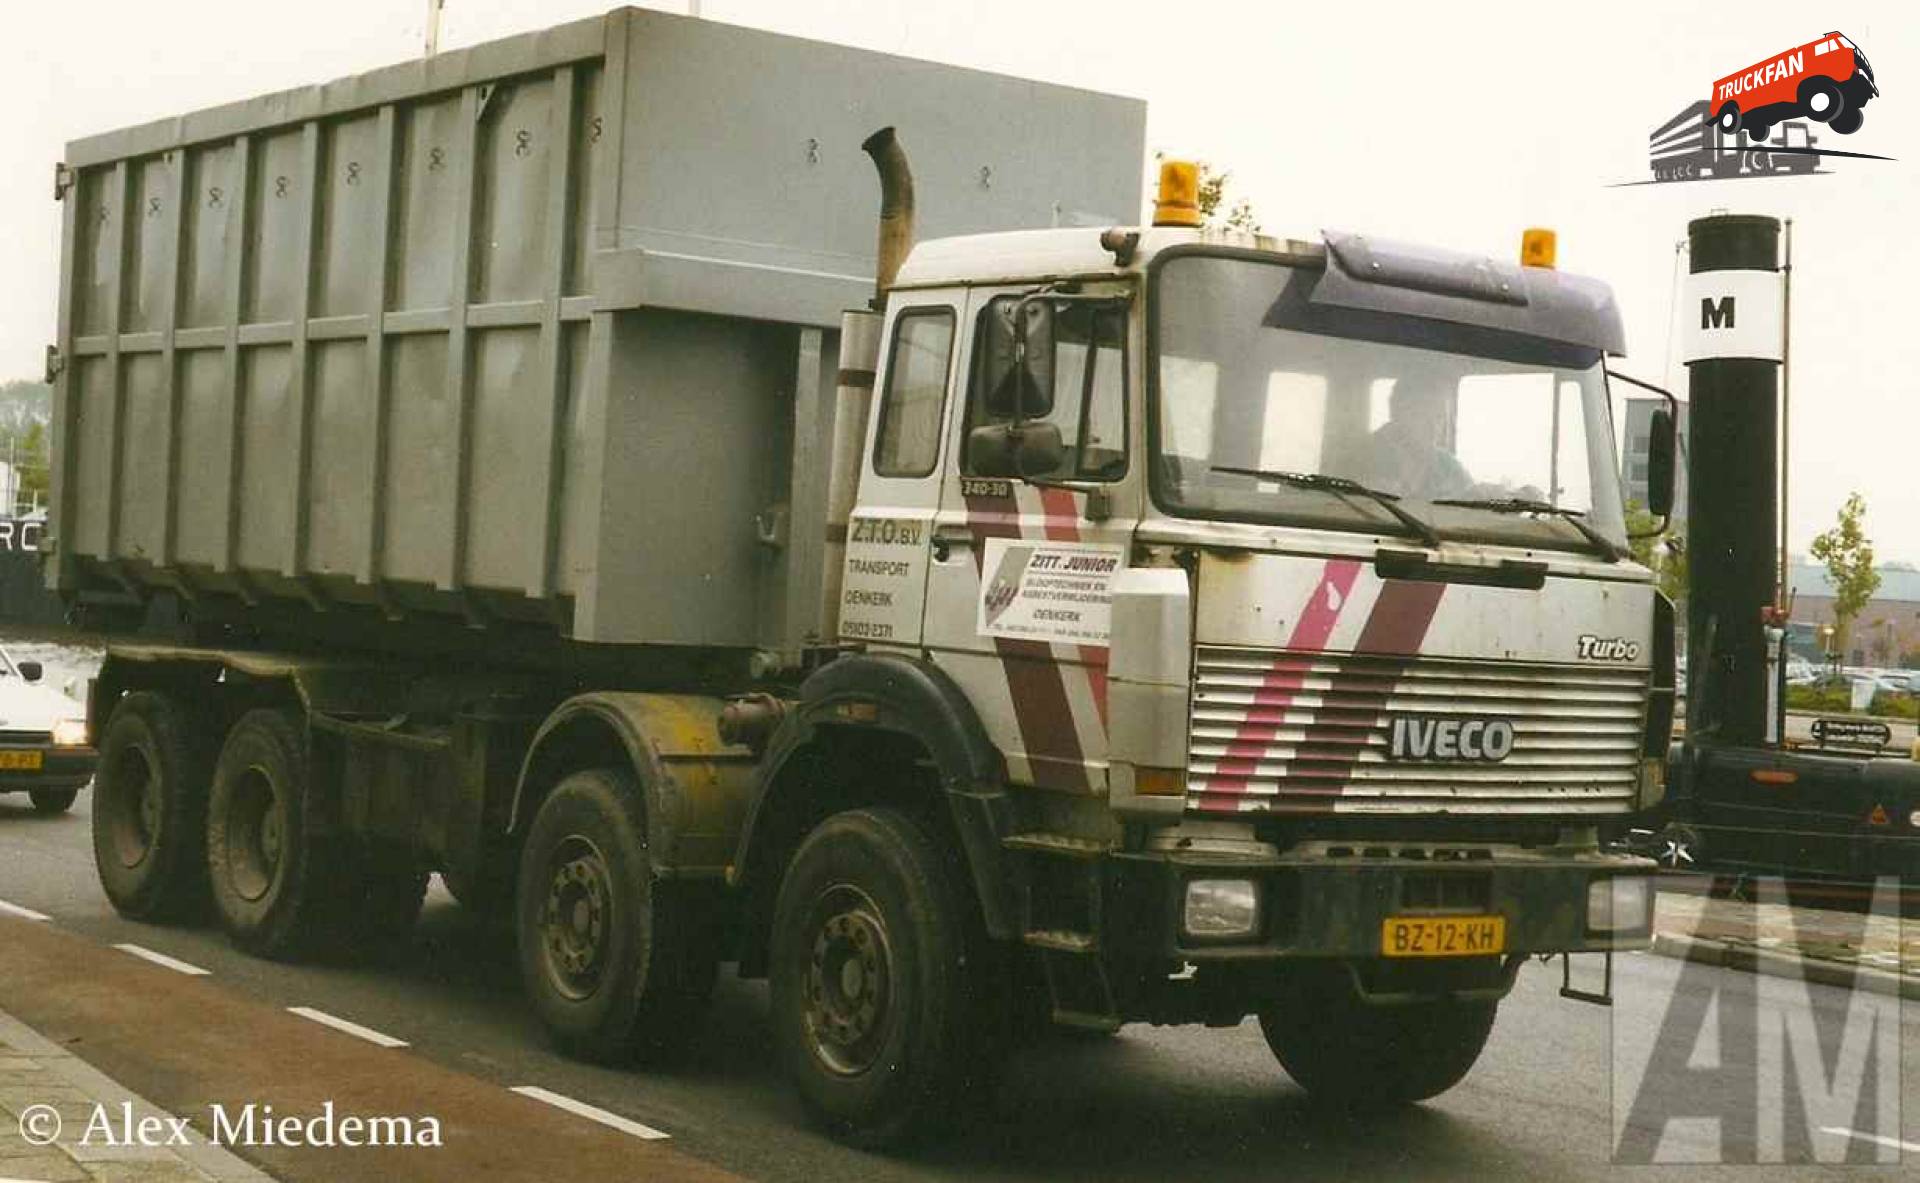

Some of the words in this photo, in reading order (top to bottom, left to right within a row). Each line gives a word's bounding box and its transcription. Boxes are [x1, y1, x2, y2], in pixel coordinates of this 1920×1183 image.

[1701, 297, 1736, 330] M
[848, 559, 910, 577] TRANSPORT
[1063, 556, 1118, 573] JUNIOR
[1577, 634, 1640, 662] Turbo
[1390, 717, 1514, 763] IVECO
[1395, 923, 1495, 951] BZ-12-KH
